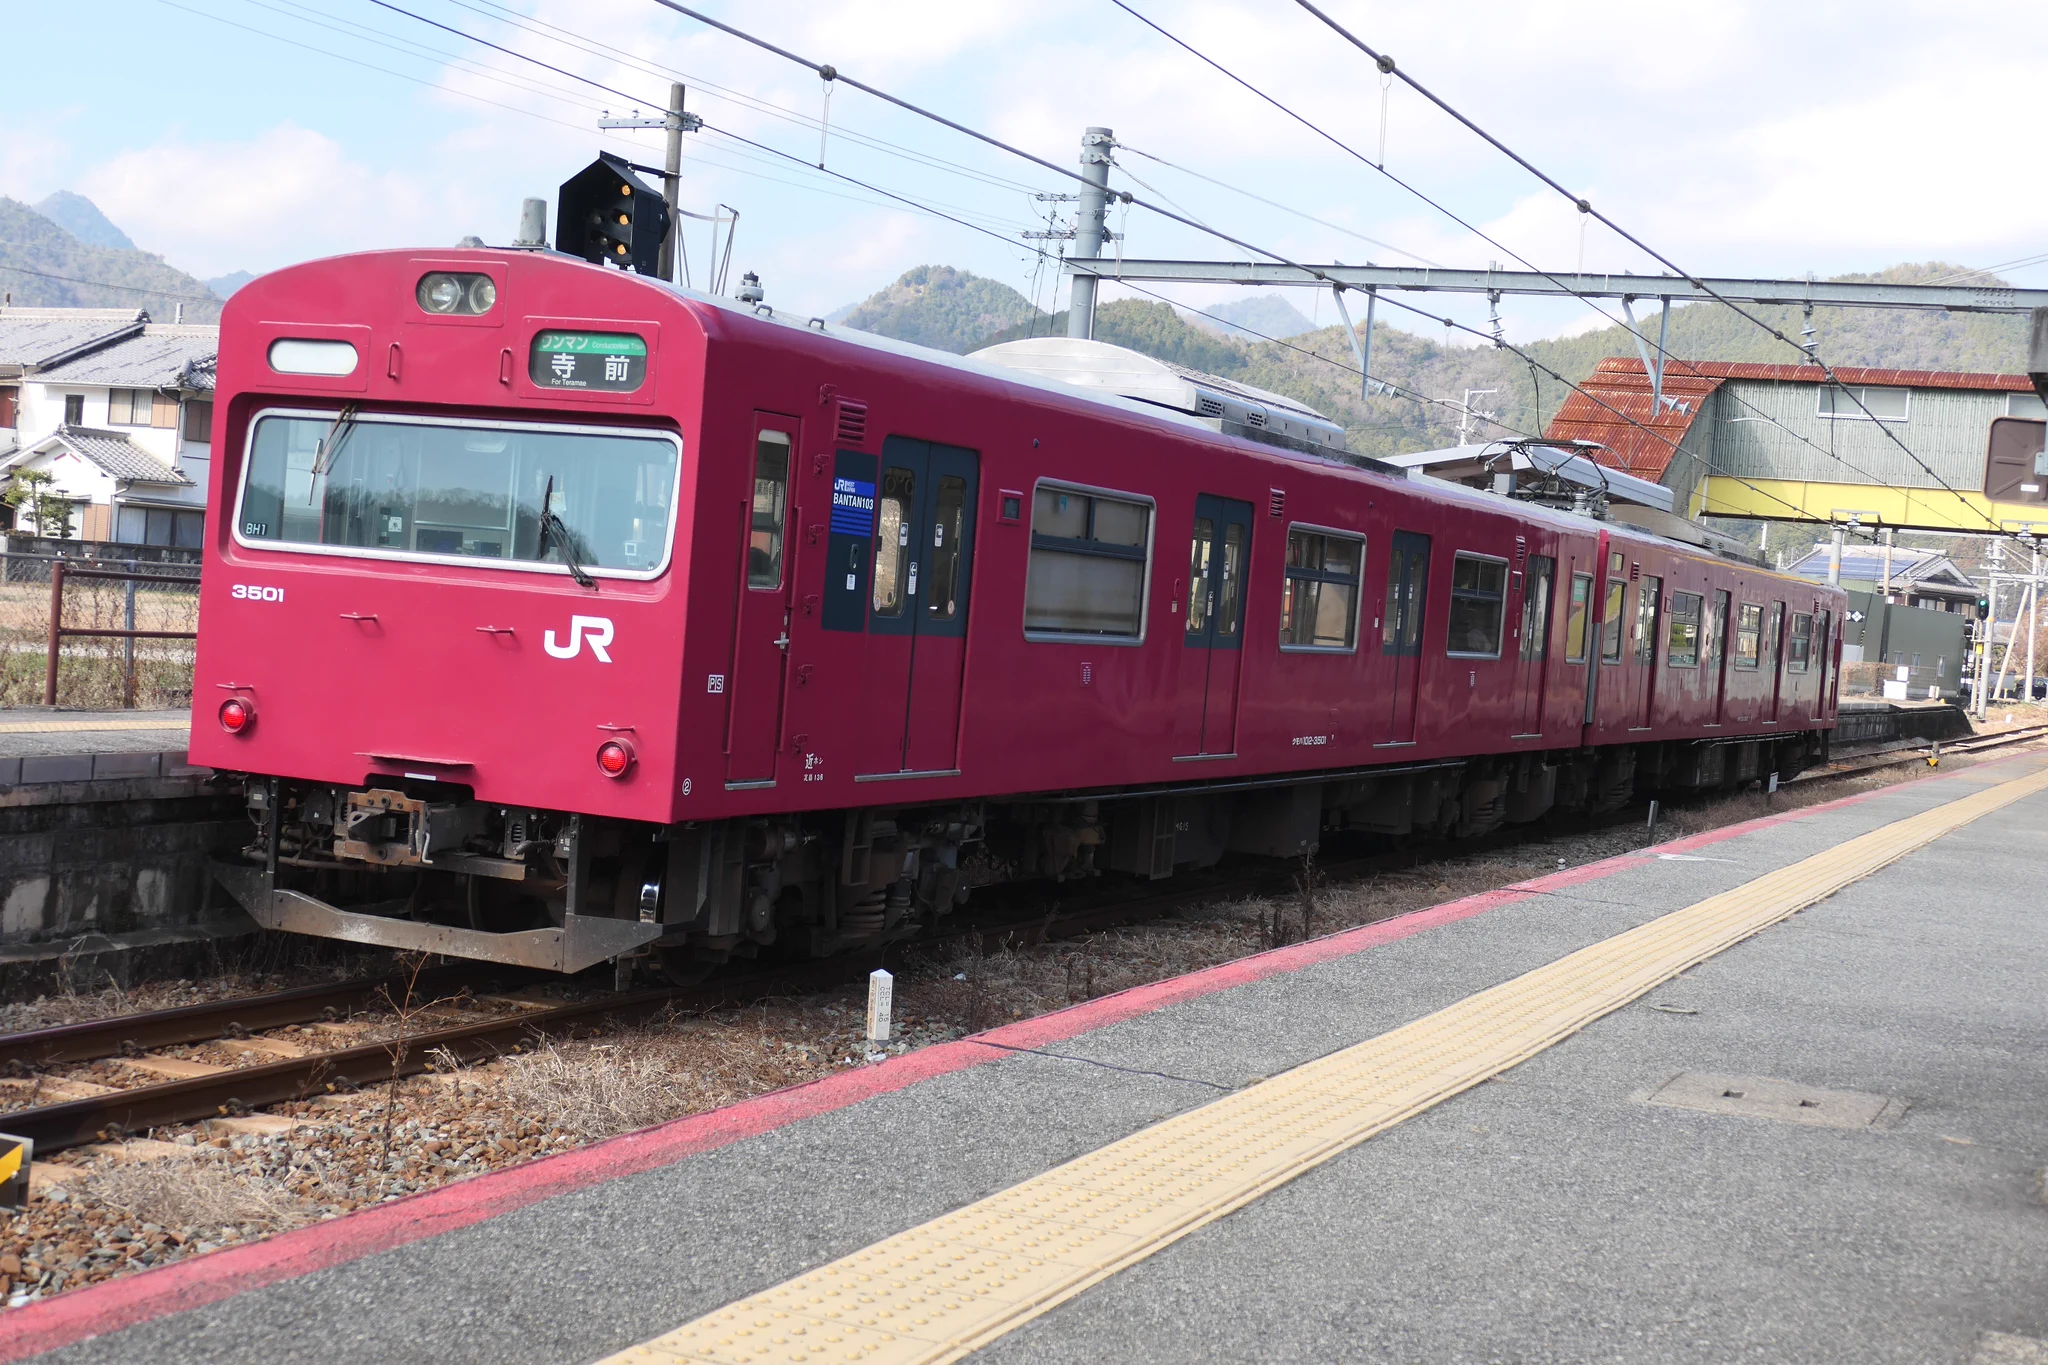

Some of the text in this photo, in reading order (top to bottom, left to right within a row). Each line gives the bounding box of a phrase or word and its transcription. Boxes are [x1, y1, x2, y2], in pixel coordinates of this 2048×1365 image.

[543, 335, 588, 350] ワンマン
[562, 379, 587, 387] Teramae
[833, 493, 874, 510] BANTAN103
[246, 522, 266, 535] BH1
[231, 584, 284, 602] 3501
[543, 614, 614, 663] JR
